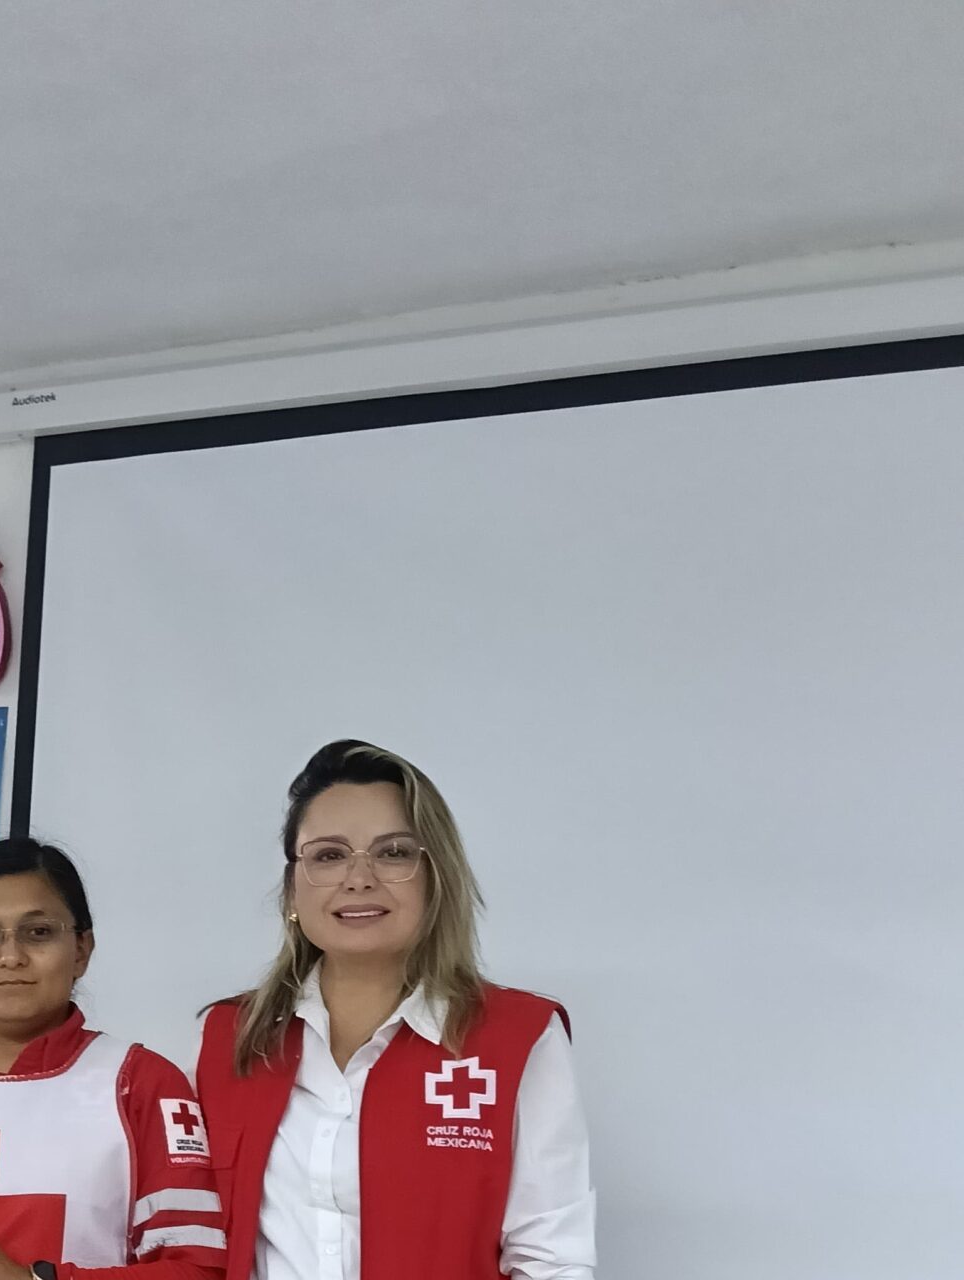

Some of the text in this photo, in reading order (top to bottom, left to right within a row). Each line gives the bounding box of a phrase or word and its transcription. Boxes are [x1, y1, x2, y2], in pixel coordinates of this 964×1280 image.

[12, 391, 56, 406] Audiotek
[426, 1126, 494, 1139] CRUZ ROJA
[427, 1137, 493, 1152] MEXICANA
